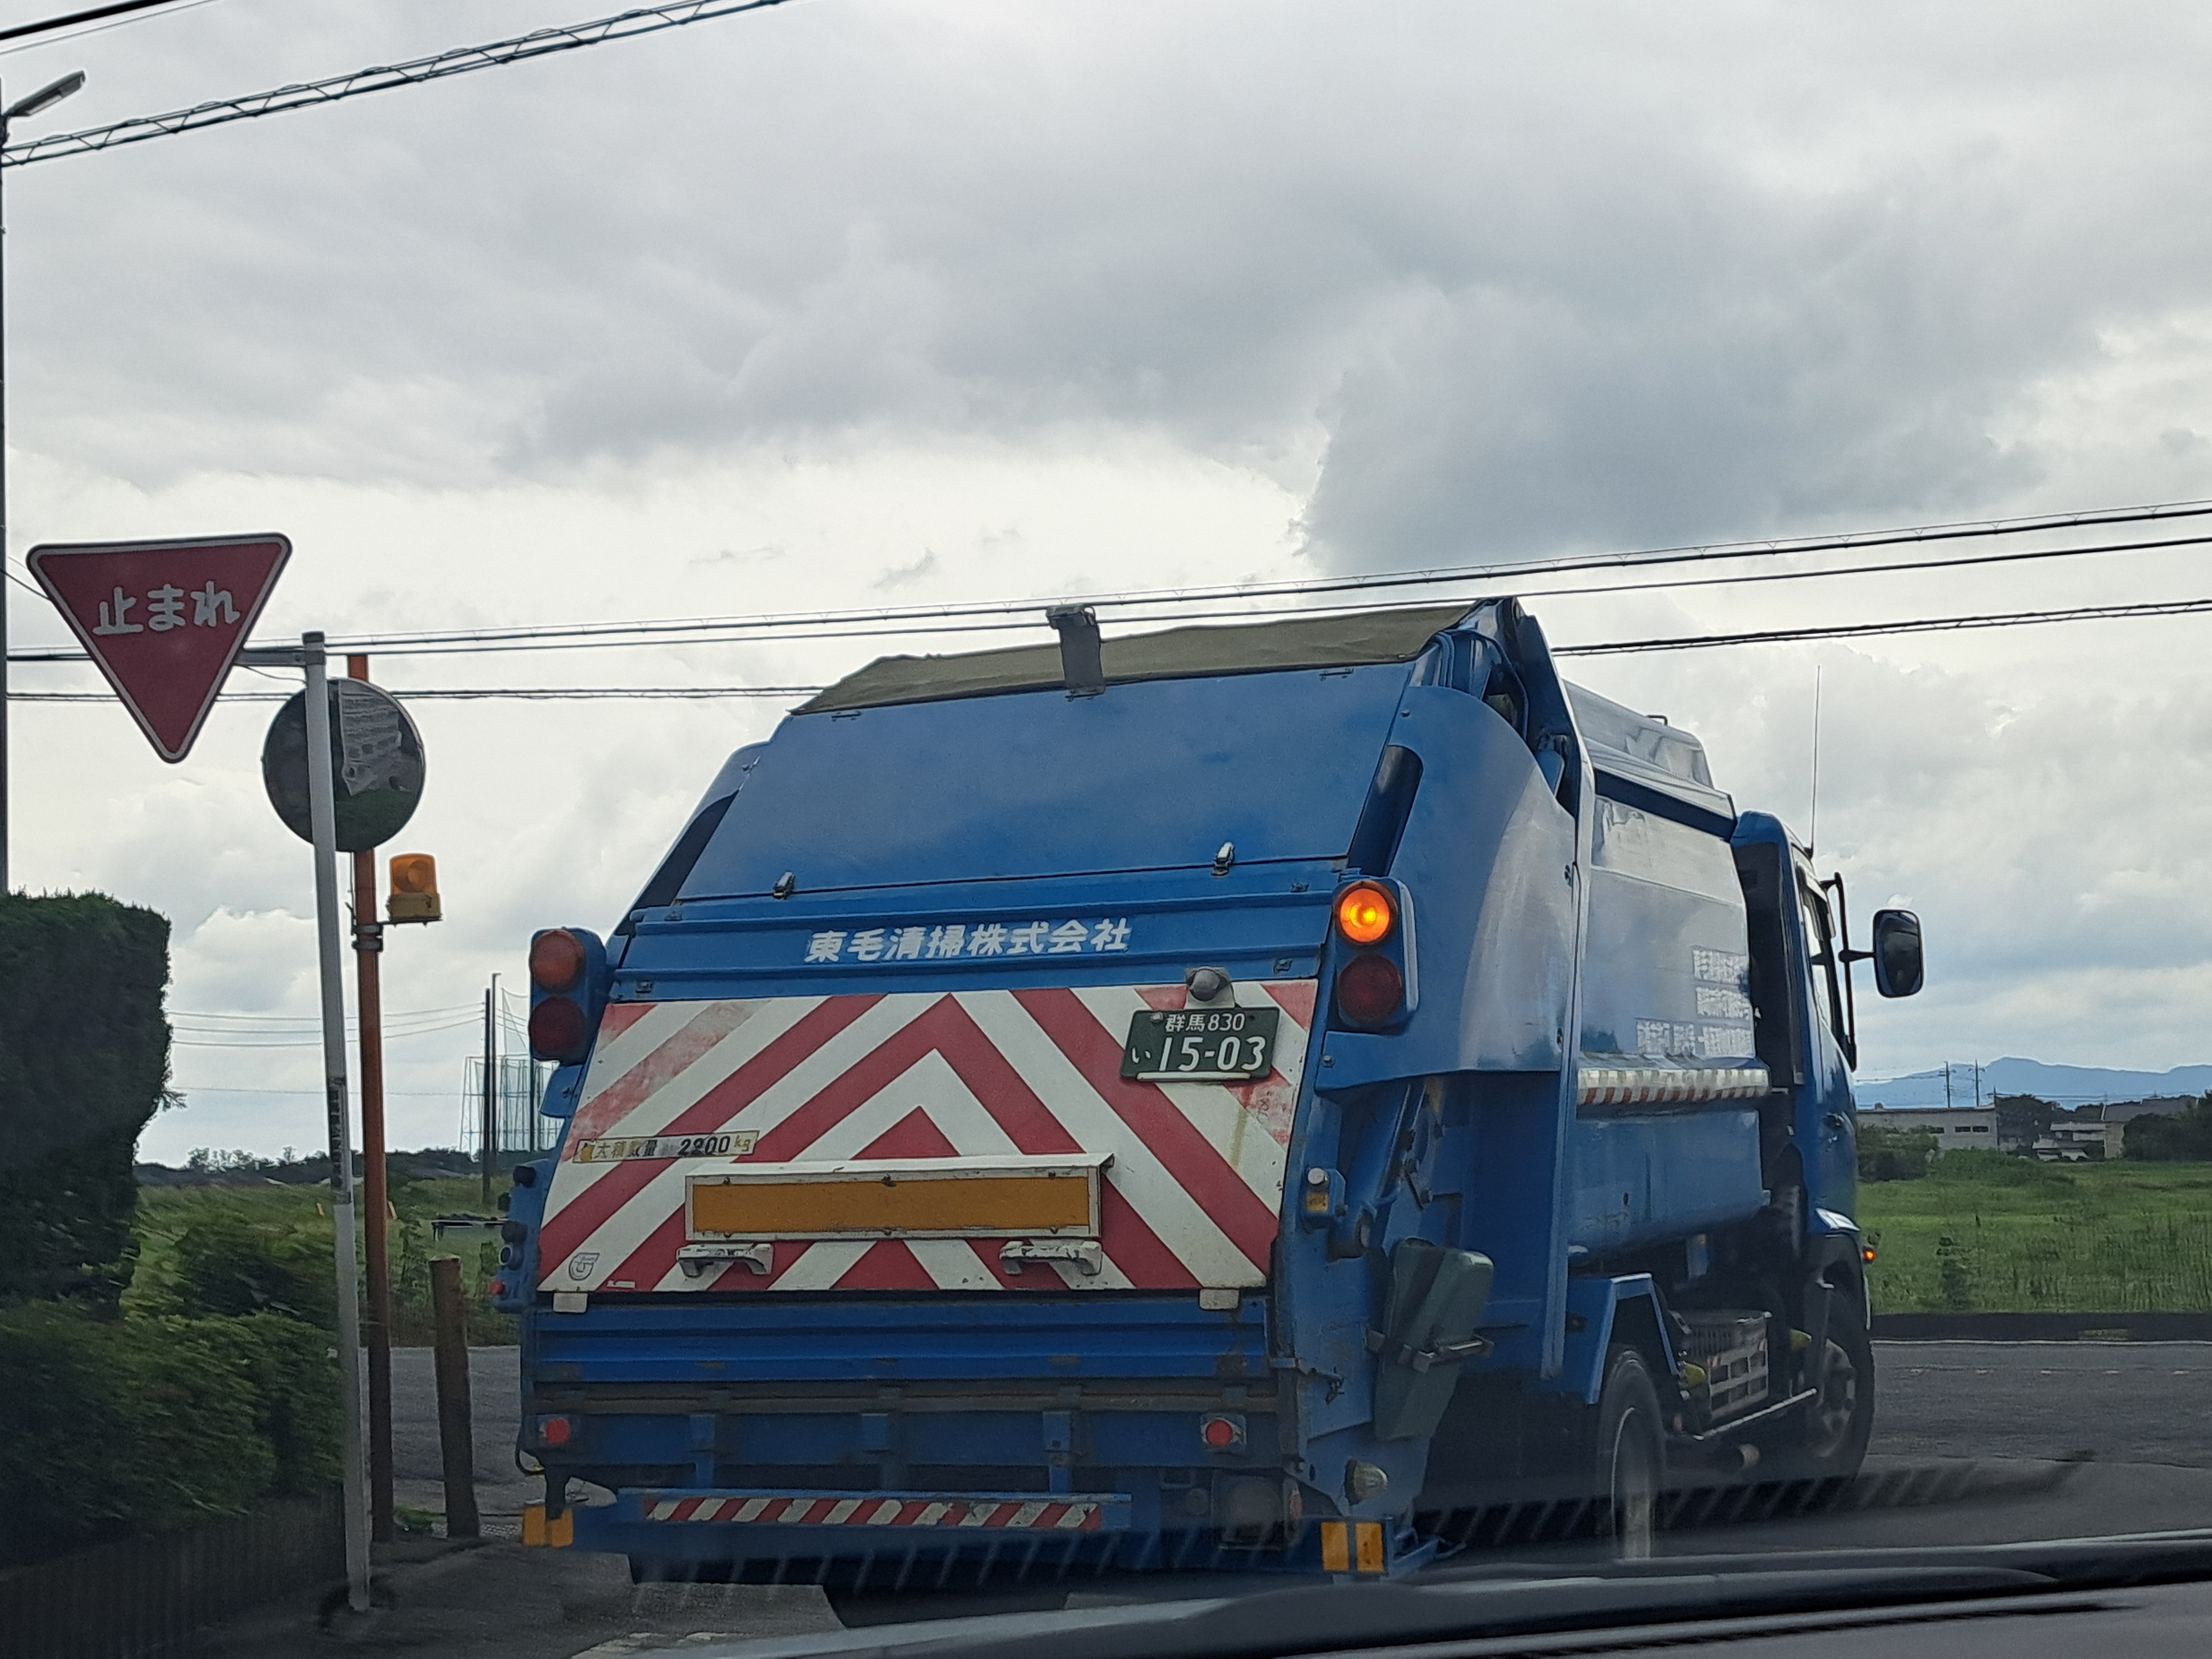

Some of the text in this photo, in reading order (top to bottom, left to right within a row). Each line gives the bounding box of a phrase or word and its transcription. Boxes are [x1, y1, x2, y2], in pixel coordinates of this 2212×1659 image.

[91, 579, 242, 637] 止まれ
[804, 917, 1132, 963] 東毛清掃株式会社
